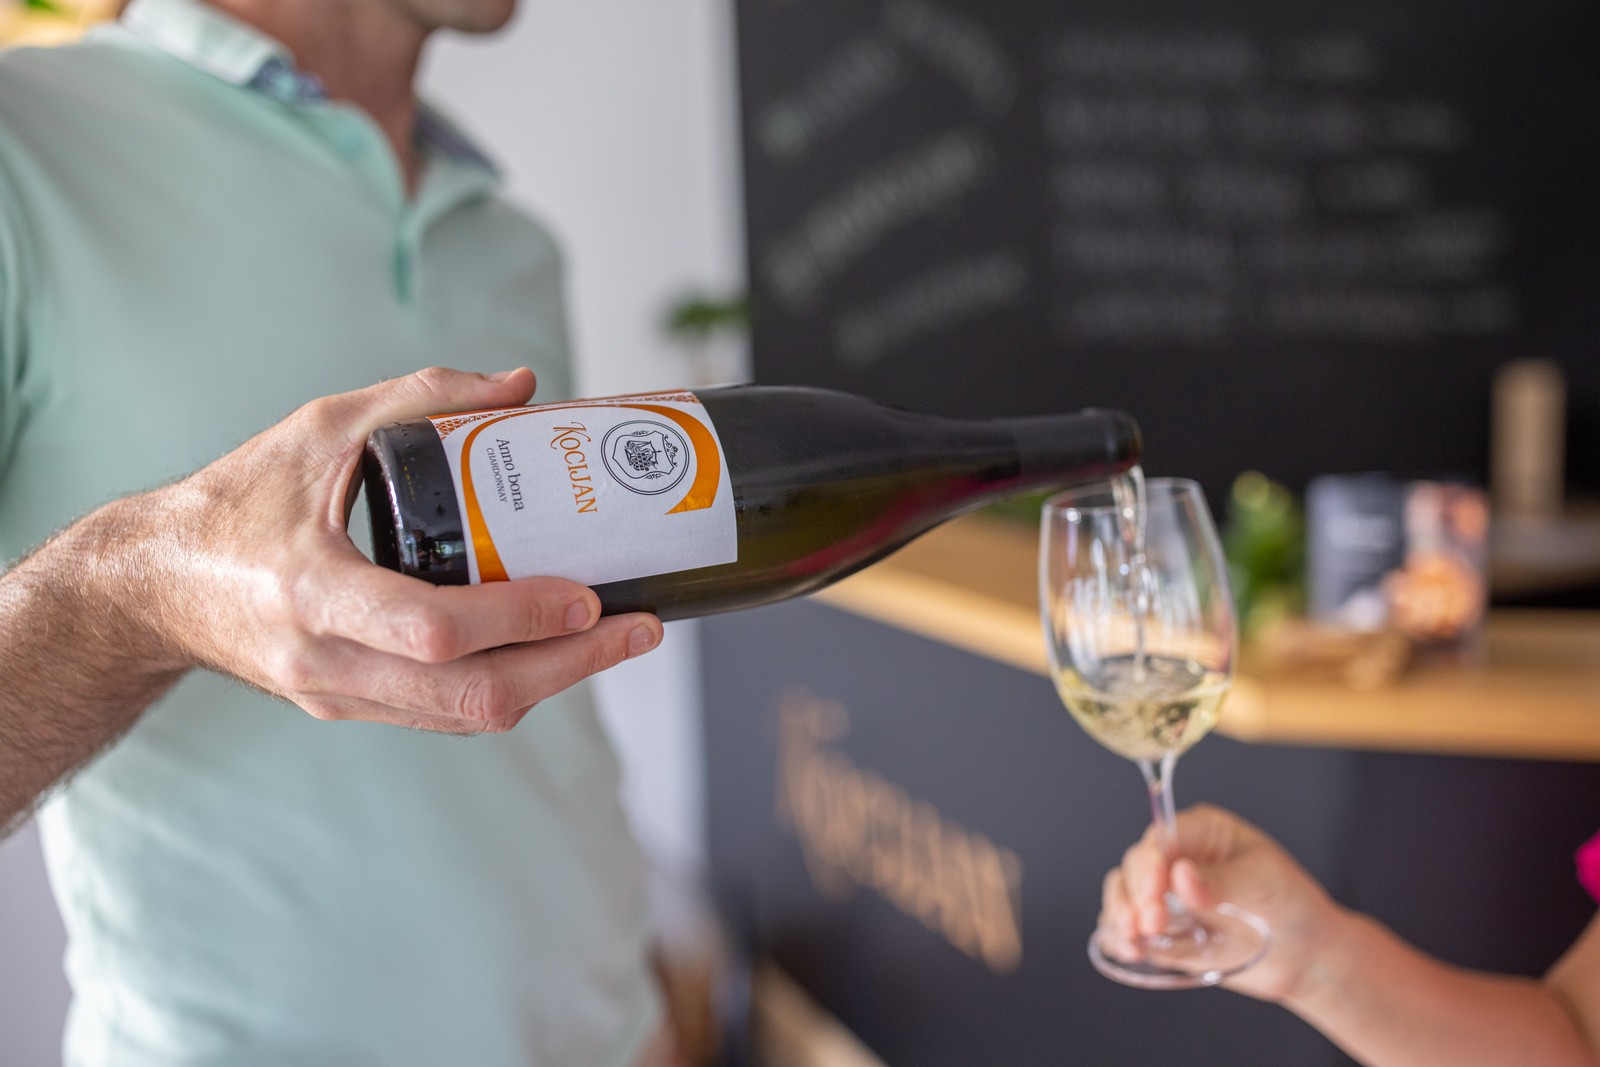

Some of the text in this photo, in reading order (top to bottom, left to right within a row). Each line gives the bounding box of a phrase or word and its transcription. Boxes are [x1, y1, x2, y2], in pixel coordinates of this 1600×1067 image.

[486, 447, 508, 503] CHARDONNAY
[495, 438, 525, 512] Anno bona
[550, 421, 598, 514] KOCIJAN
